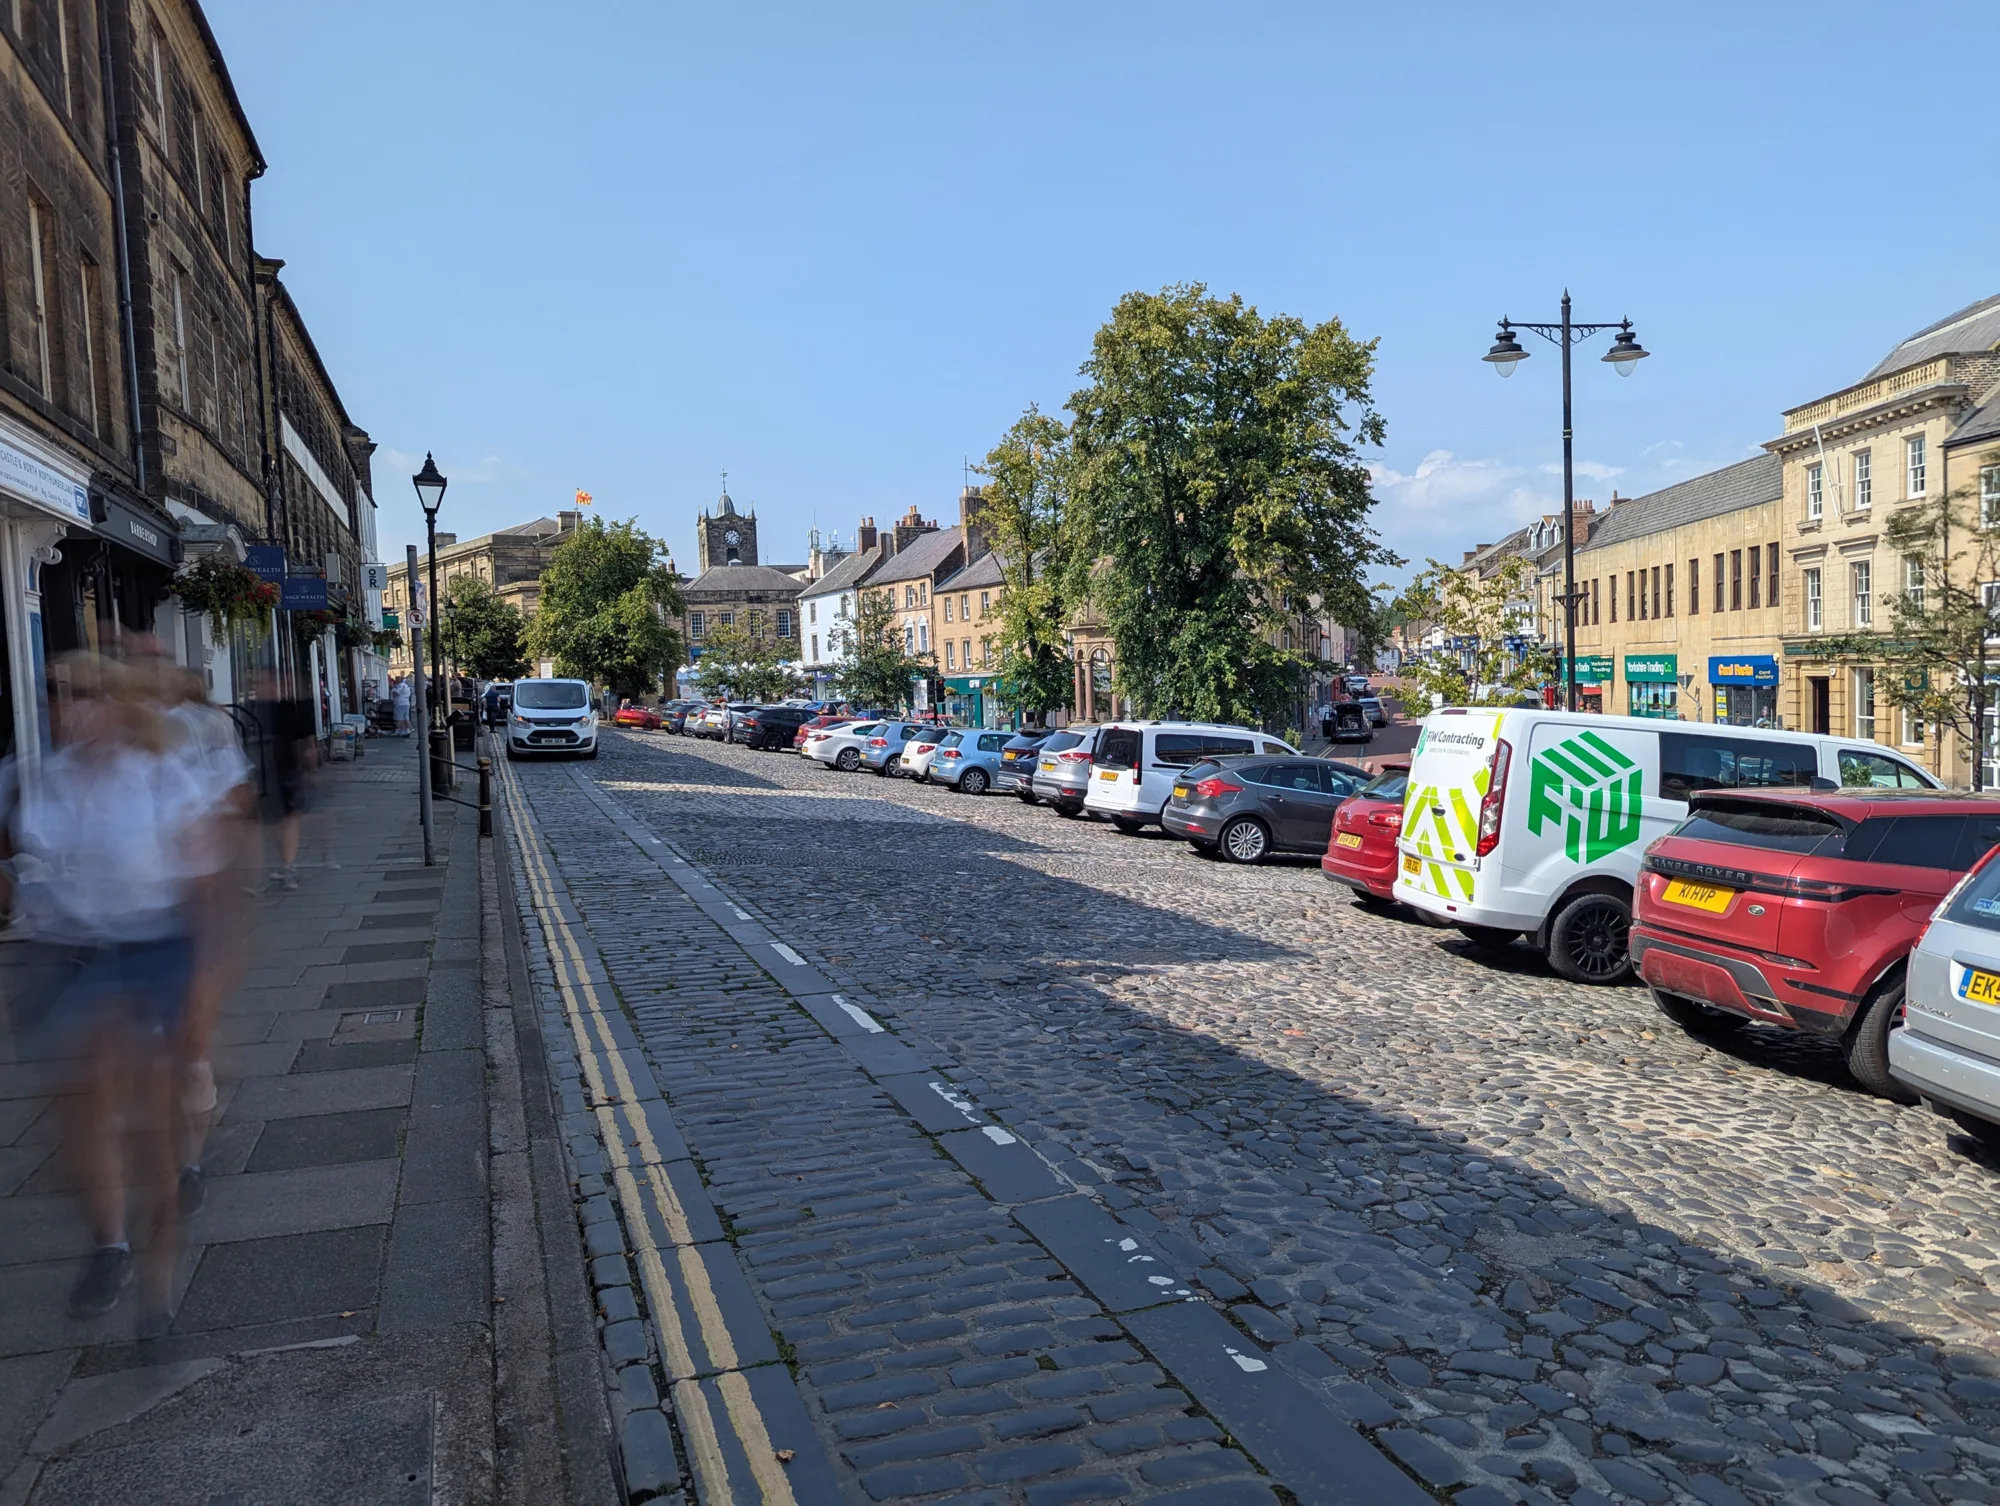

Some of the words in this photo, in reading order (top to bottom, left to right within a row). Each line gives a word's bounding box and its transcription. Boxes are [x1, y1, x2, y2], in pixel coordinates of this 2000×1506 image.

[23, 461, 38, 475] NORTH
[38, 469, 73, 496] NORTHUMBERLAND
[130, 520, 157, 547] BARBERSHOP
[1627, 662, 1647, 673] Yorkshire
[1647, 662, 1664, 675] Trading
[1664, 662, 1672, 672] Co.
[1718, 664, 1734, 676] Card
[1438, 731, 1485, 750] Contracting
[1654, 858, 1689, 871] RANGE
[1696, 865, 1746, 880] ROVER
[1689, 886, 1717, 904] HVP
